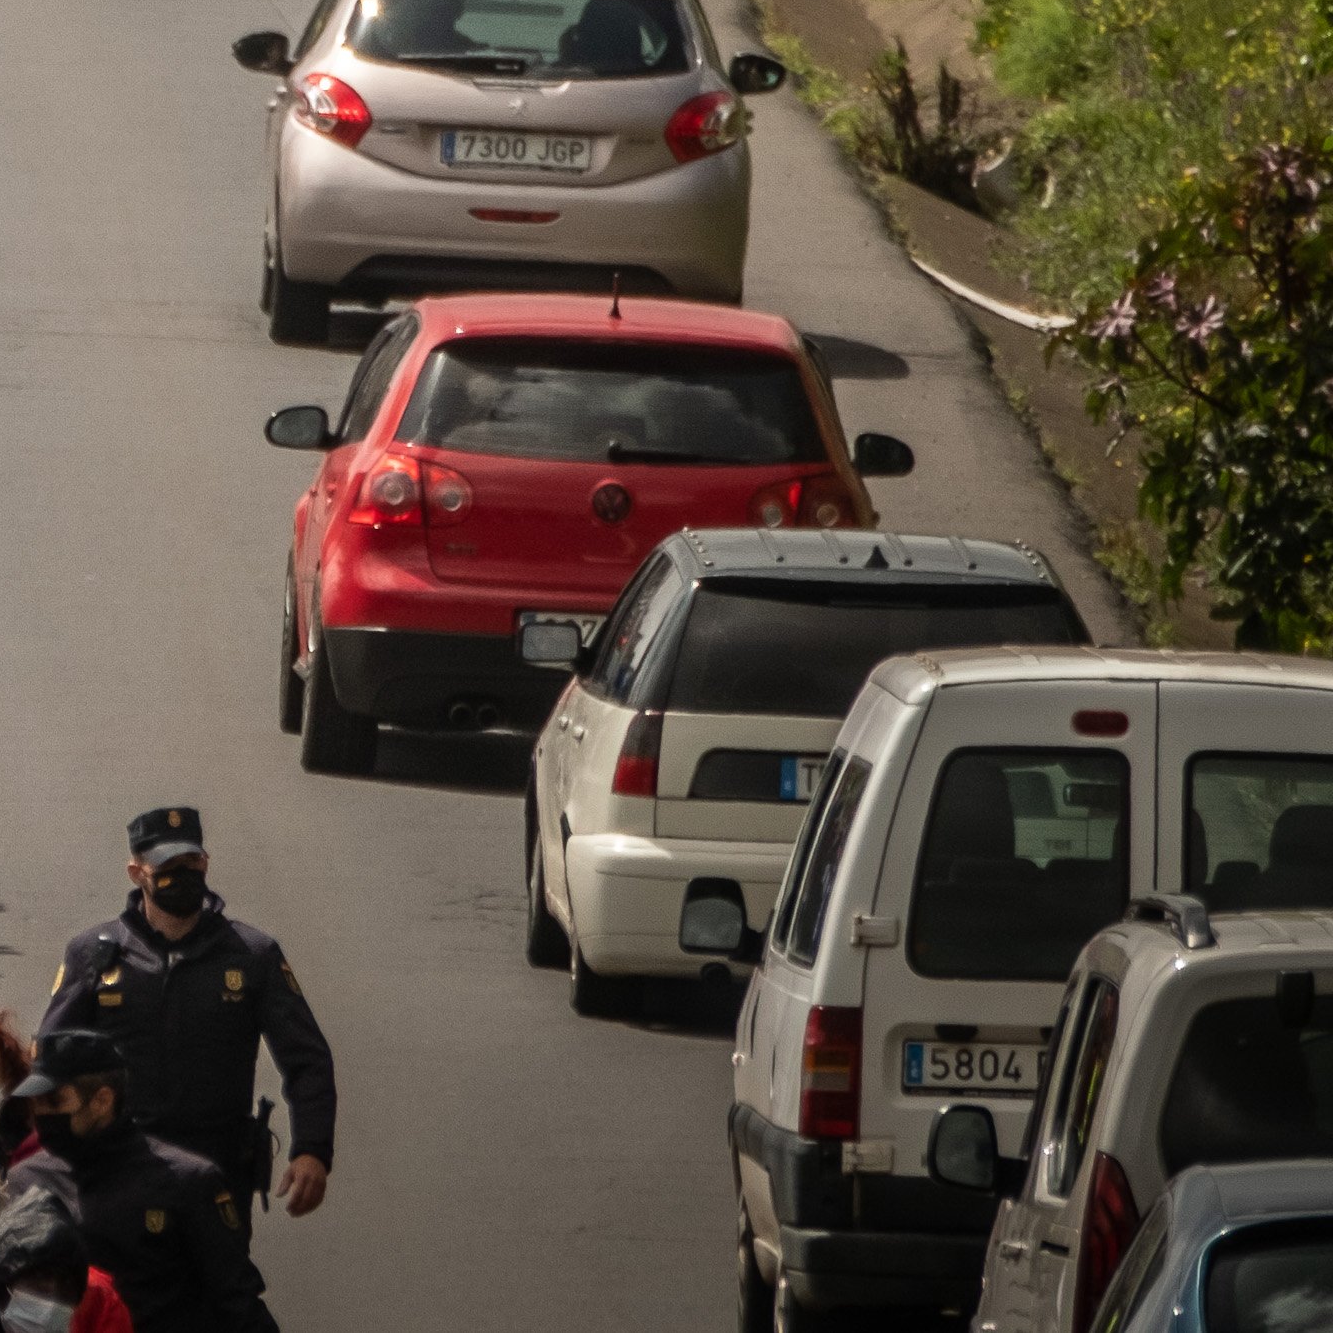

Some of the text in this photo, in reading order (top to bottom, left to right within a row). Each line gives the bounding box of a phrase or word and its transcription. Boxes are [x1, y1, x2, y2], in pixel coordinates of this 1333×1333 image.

[461, 134, 584, 165] 7300 JGP
[930, 1047, 1022, 1083] 5804
